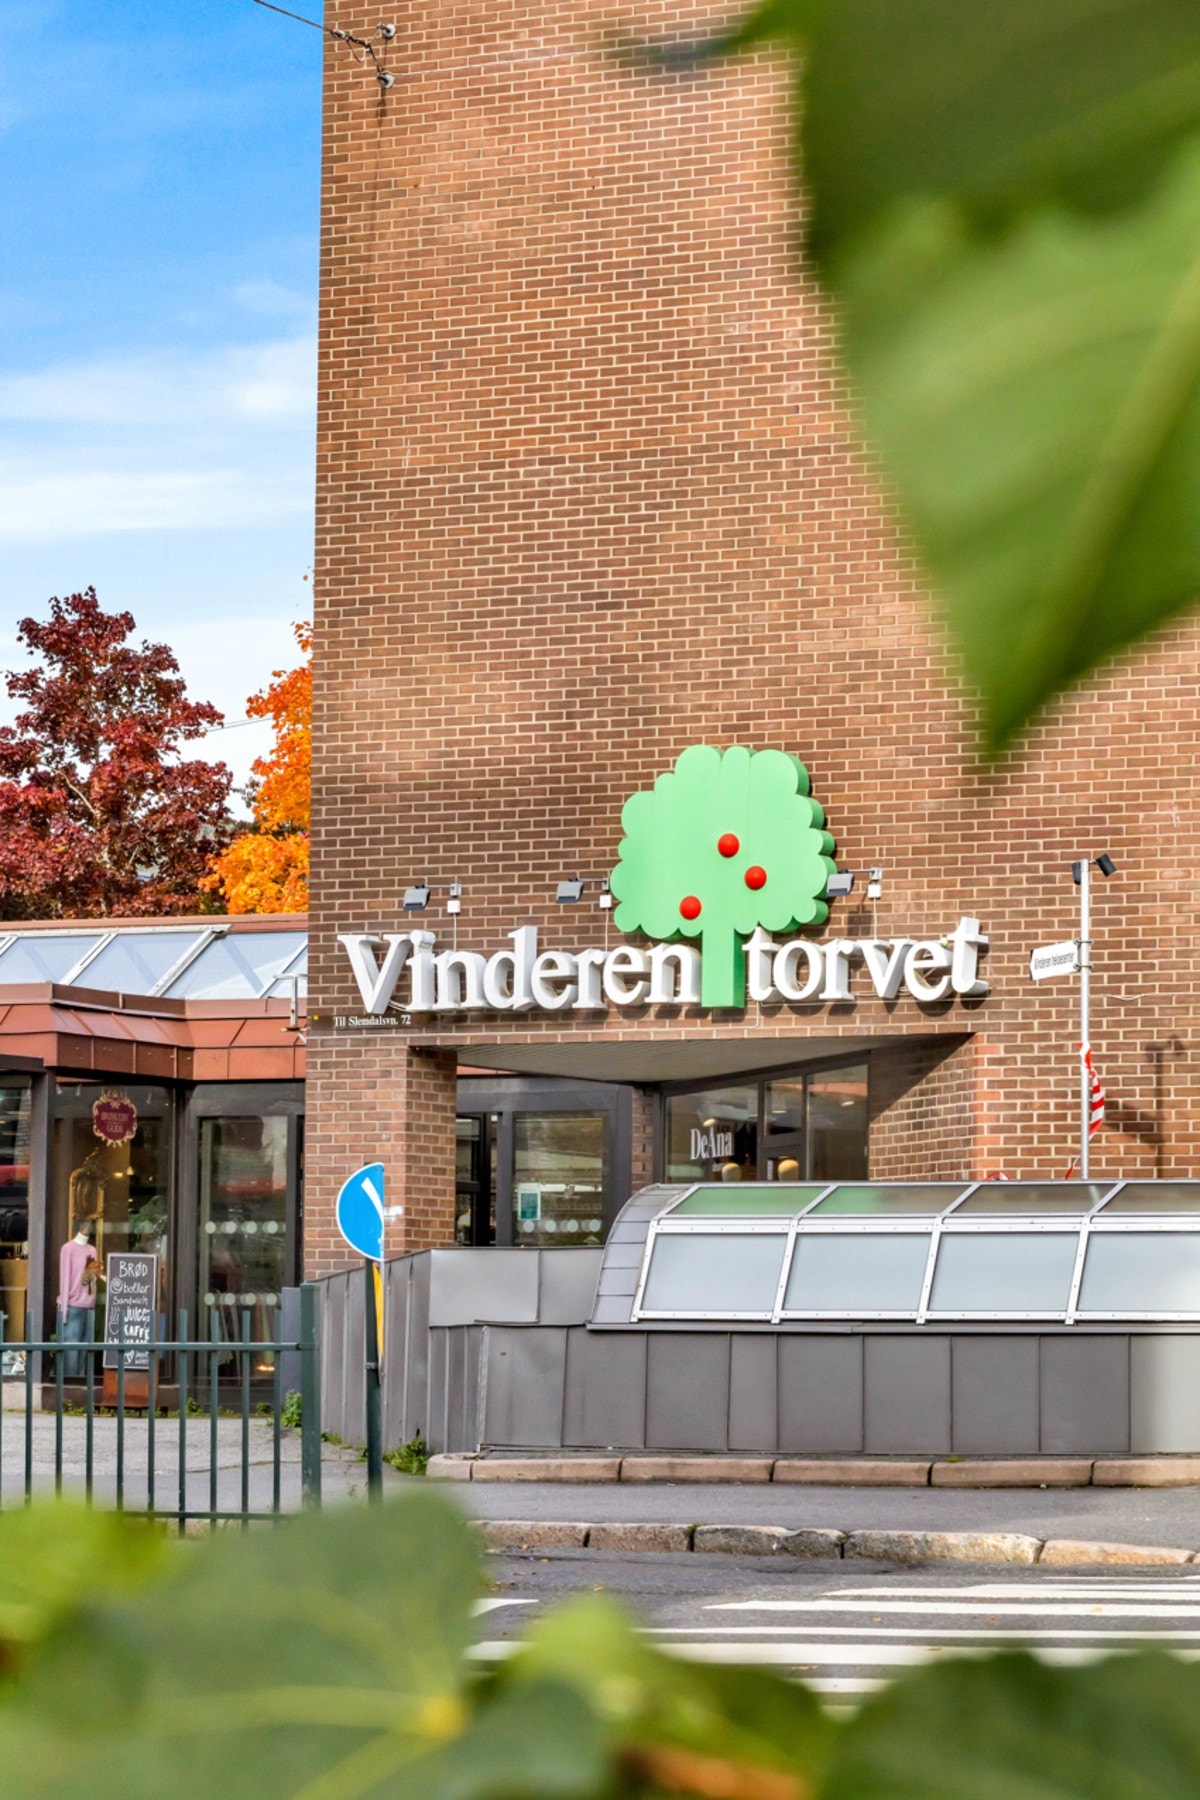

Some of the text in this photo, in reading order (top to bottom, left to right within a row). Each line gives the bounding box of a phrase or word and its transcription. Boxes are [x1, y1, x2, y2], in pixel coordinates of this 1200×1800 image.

[338, 917, 988, 1012] Vinderen torvet
[334, 1016, 346, 1026] Til
[401, 1014, 411, 1025] 72
[690, 1126, 733, 1160] DeAna
[119, 1260, 148, 1278] BRØD
